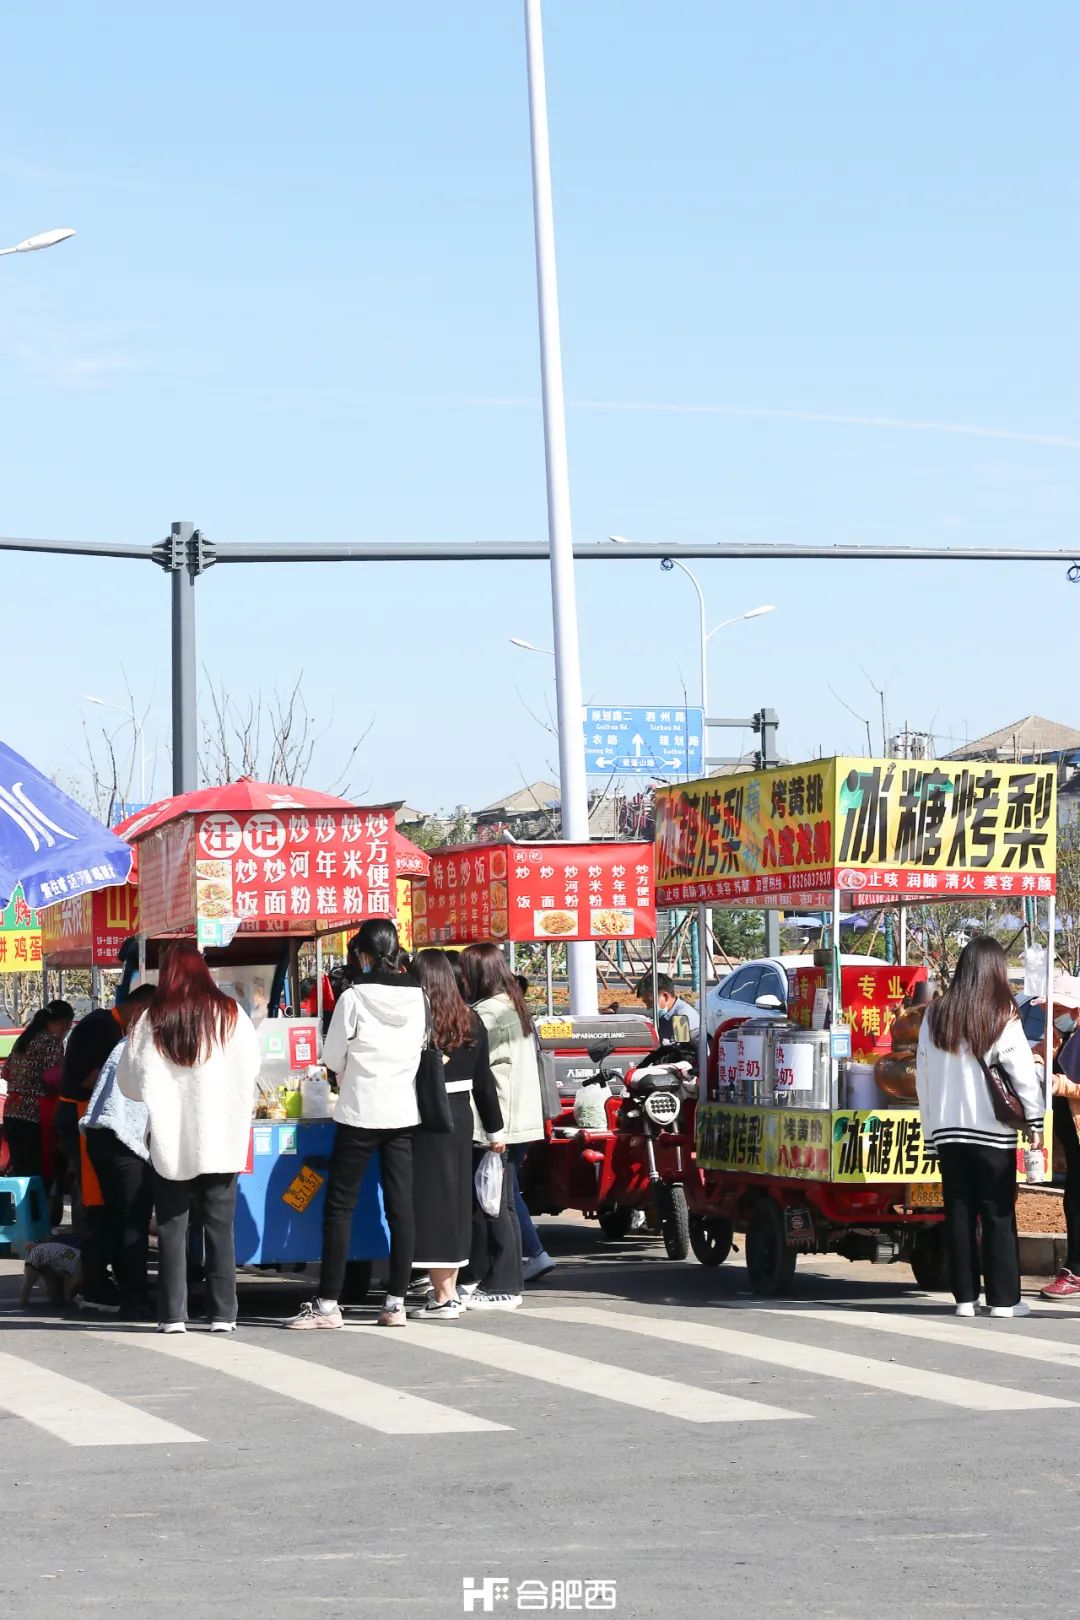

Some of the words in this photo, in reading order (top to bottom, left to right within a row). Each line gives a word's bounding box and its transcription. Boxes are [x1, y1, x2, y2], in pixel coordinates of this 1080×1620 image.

[770, 773, 823, 819] 烤黄桃
[839, 766, 1054, 869] 冰糖烤梨
[202, 818, 281, 854] 汪记
[289, 814, 311, 915] 炒河粉
[315, 814, 338, 915] 炒年糕
[341, 814, 363, 915] 炒米粉
[365, 813, 389, 914] 炒方便面
[433, 856, 486, 890] 特色炒饭
[564, 865, 579, 907] 炒河粉
[588, 865, 602, 907] 炒米粉
[635, 864, 650, 907] 炒方便面
[868, 872, 899, 888] 止咳
[906, 873, 938, 889] 润肺
[945, 874, 976, 890] 清火
[983, 875, 1014, 891] 美容
[1021, 876, 1052, 892] 养颜
[235, 859, 259, 916] 炒饭
[264, 859, 286, 915] 炒面
[858, 975, 905, 1000] 专业
